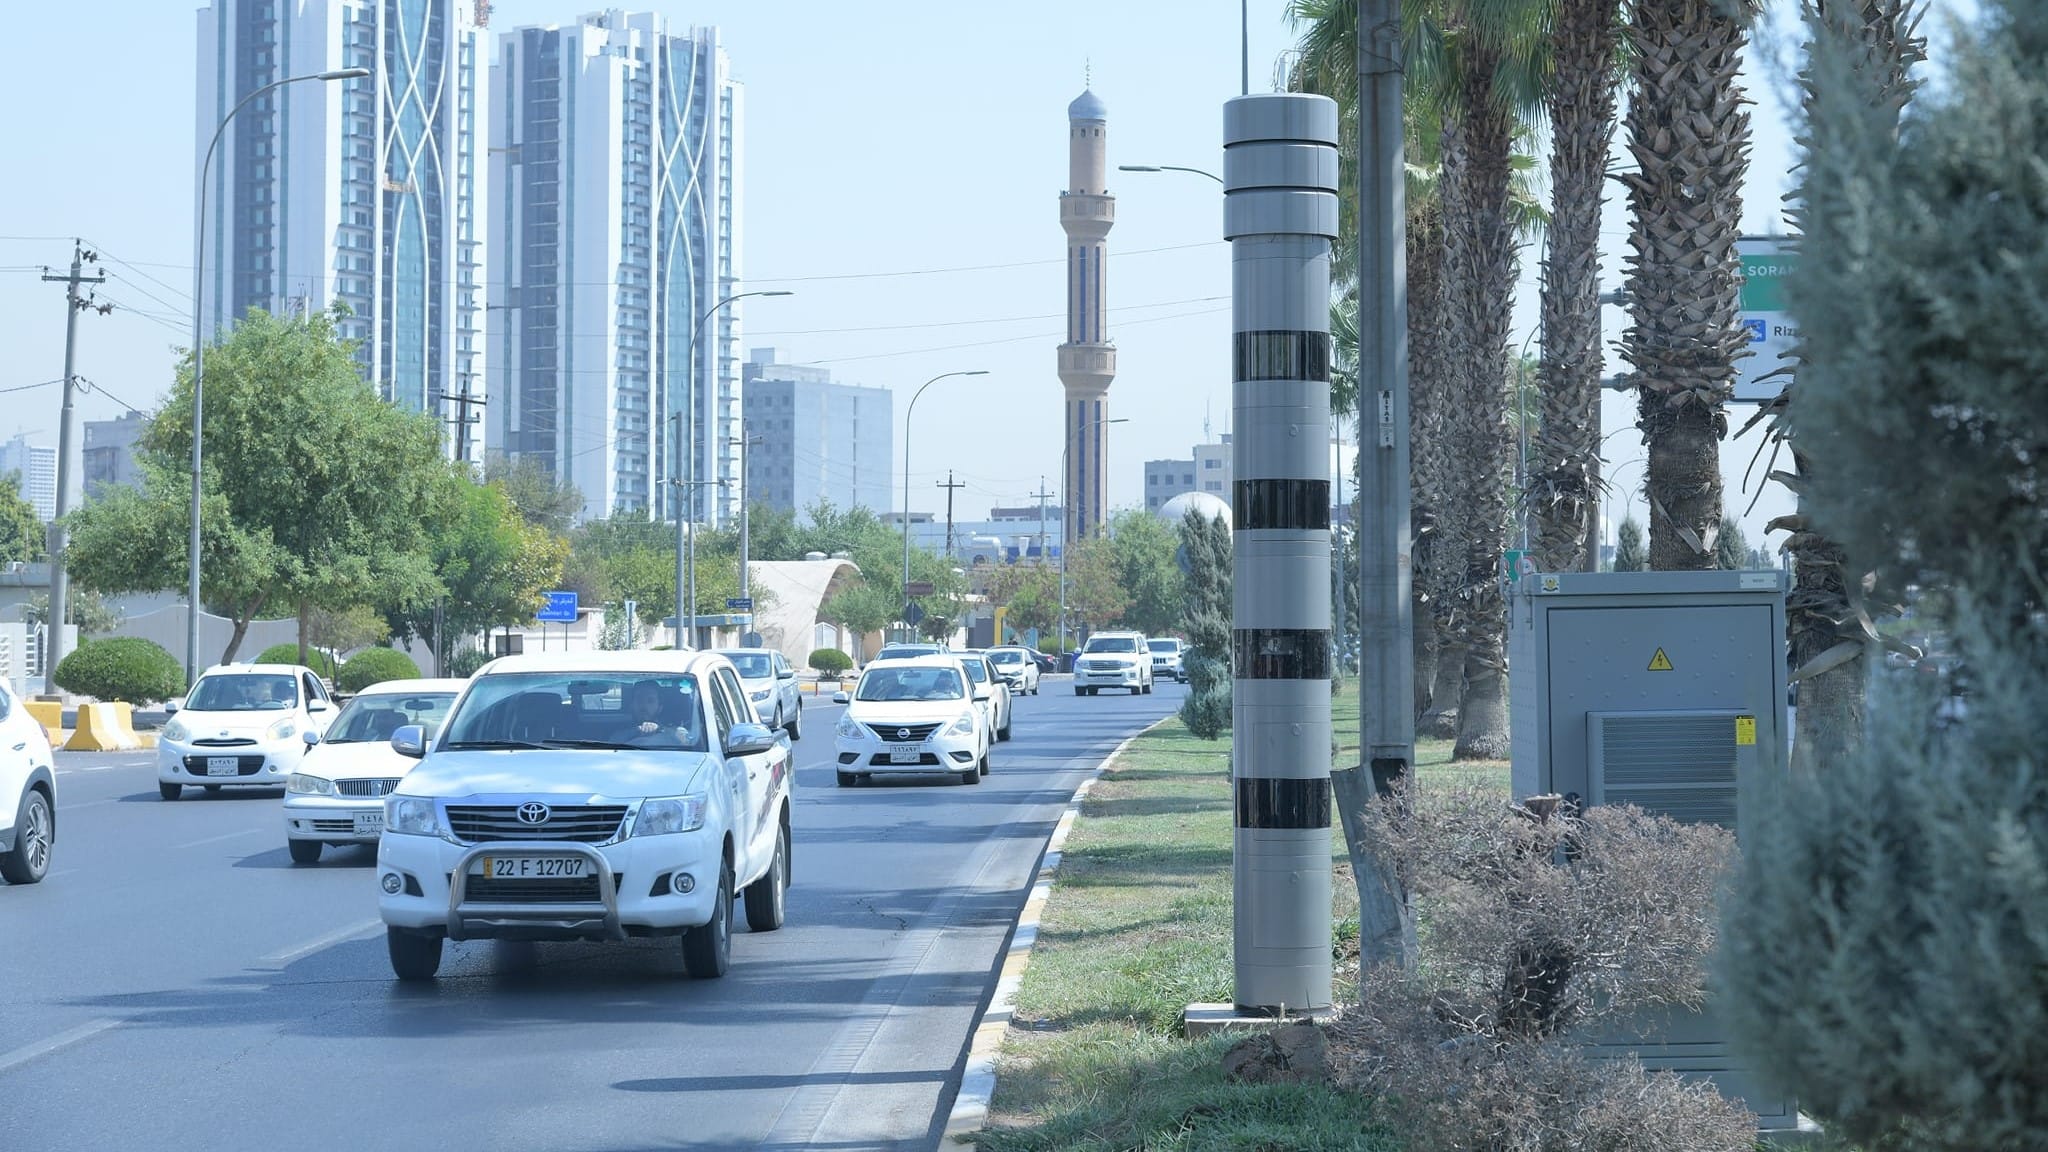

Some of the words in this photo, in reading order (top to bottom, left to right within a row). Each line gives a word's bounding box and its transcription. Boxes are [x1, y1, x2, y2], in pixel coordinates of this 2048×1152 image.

[496, 859, 514, 876] 22
[521, 859, 530, 876] F
[536, 859, 583, 876] 12707
